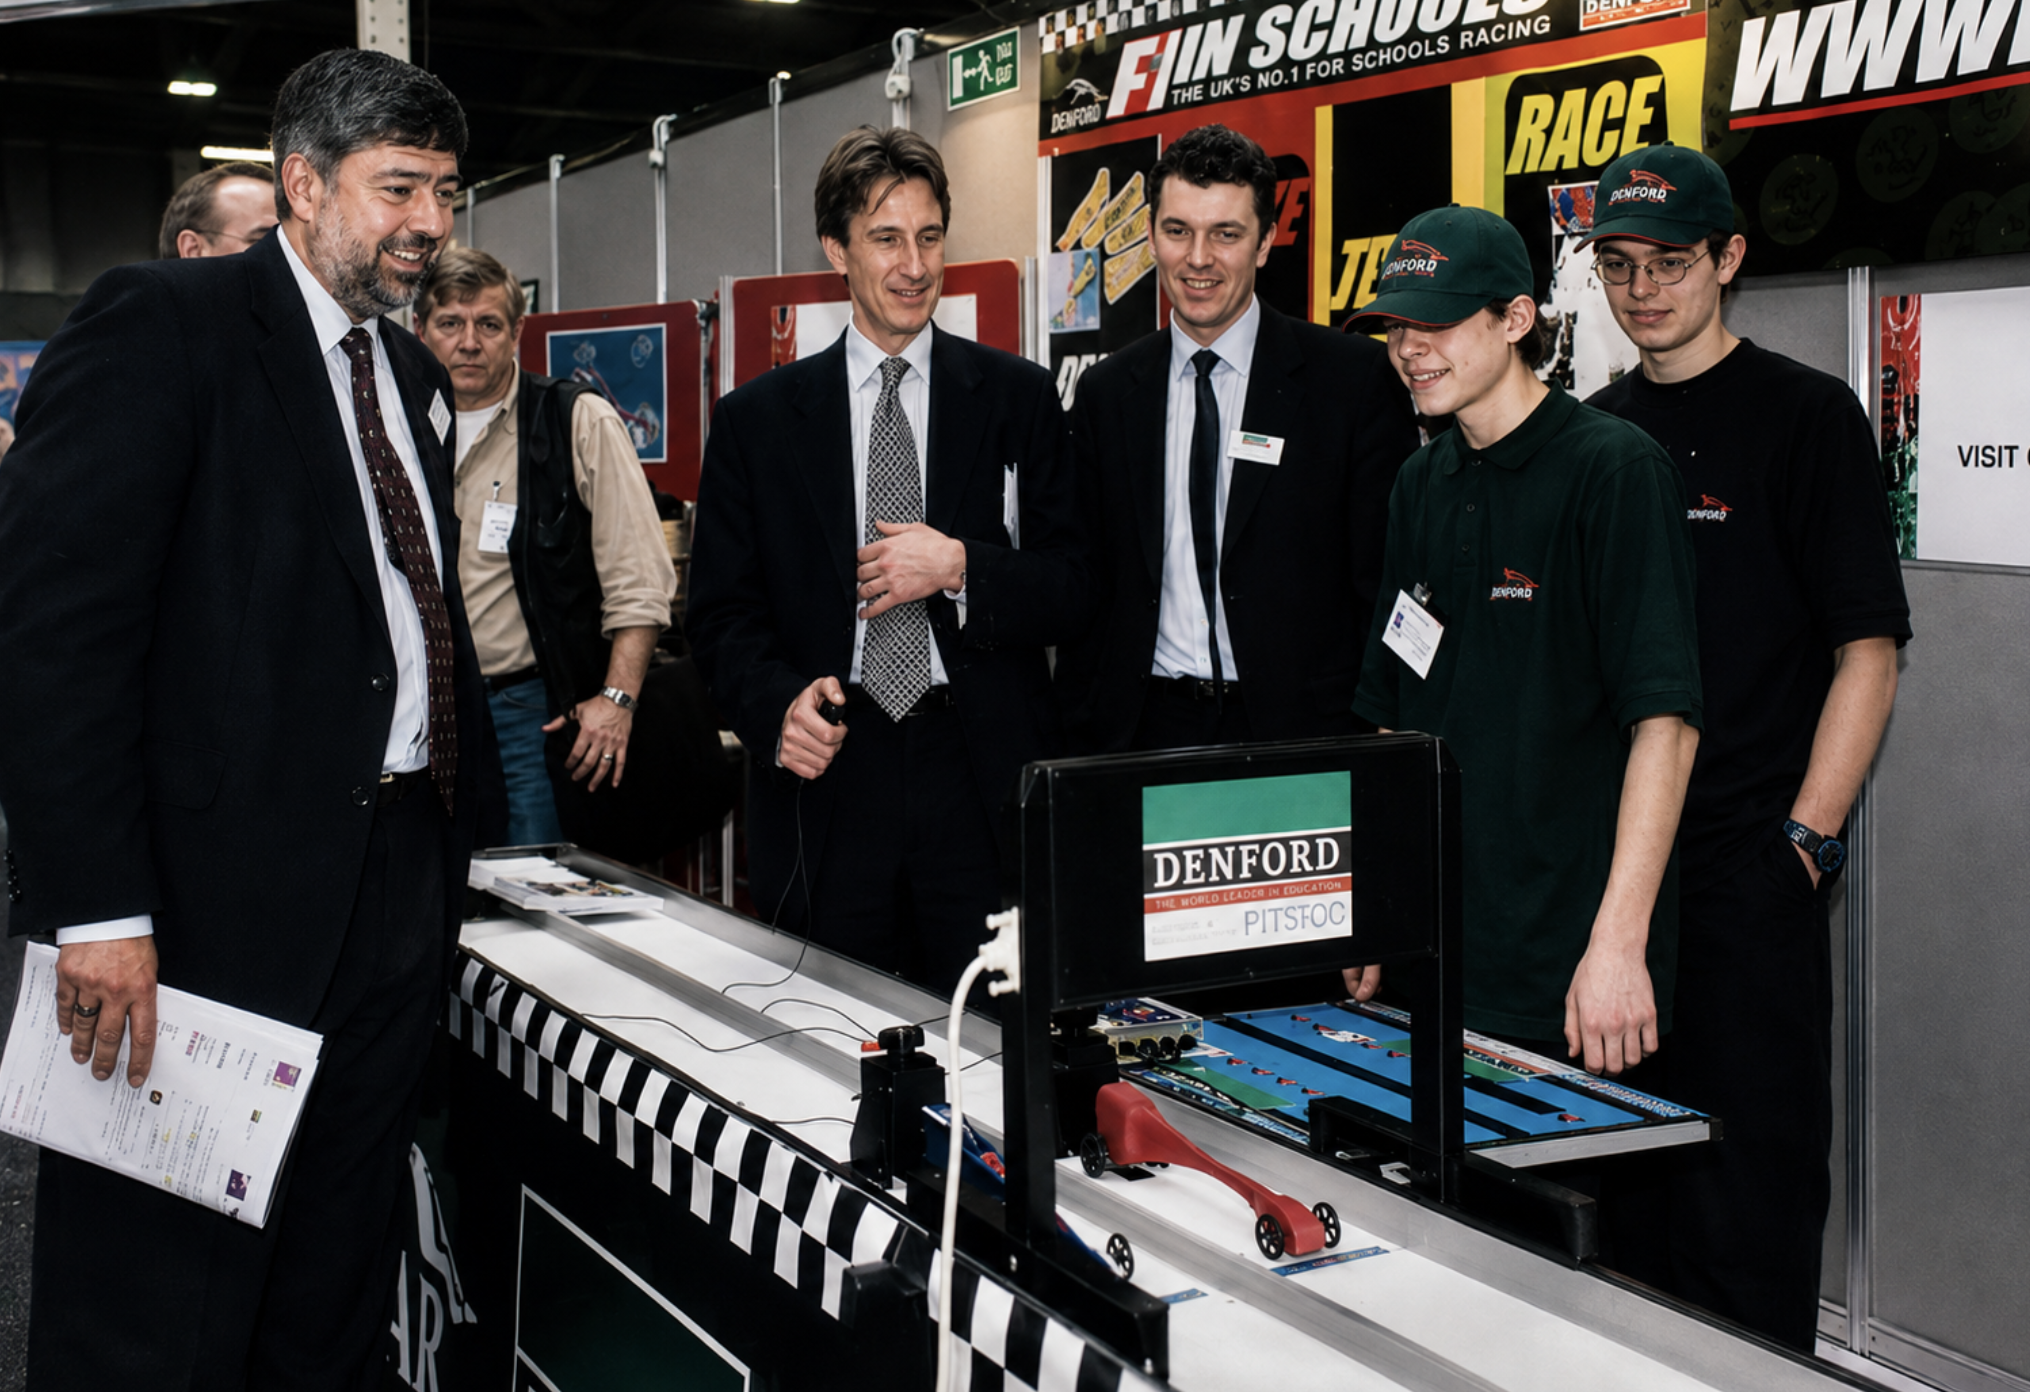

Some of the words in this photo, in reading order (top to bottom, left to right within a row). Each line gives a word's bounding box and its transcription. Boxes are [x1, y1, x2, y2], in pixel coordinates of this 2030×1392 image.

[1171, 14, 1246, 86] IN
[1171, 84, 1204, 106] THE
[1209, 75, 1252, 99] UK'S
[1257, 66, 1299, 89] NO.1
[1305, 57, 1345, 81] FOR
[1351, 35, 1450, 72] SCHOOLS
[1459, 14, 1552, 50] RACING
[1504, 74, 1664, 176] RACE
[1957, 444, 2019, 468] VISIT
[1491, 586, 1533, 599] DENFORD
[1153, 837, 1340, 888] DENFORD
[1155, 899, 1176, 910] THE
[1180, 893, 1220, 908] WORLD
[1223, 889, 1265, 903] LEADER
[1268, 886, 1280, 897] IN
[1283, 880, 1342, 896] EDUCATION
